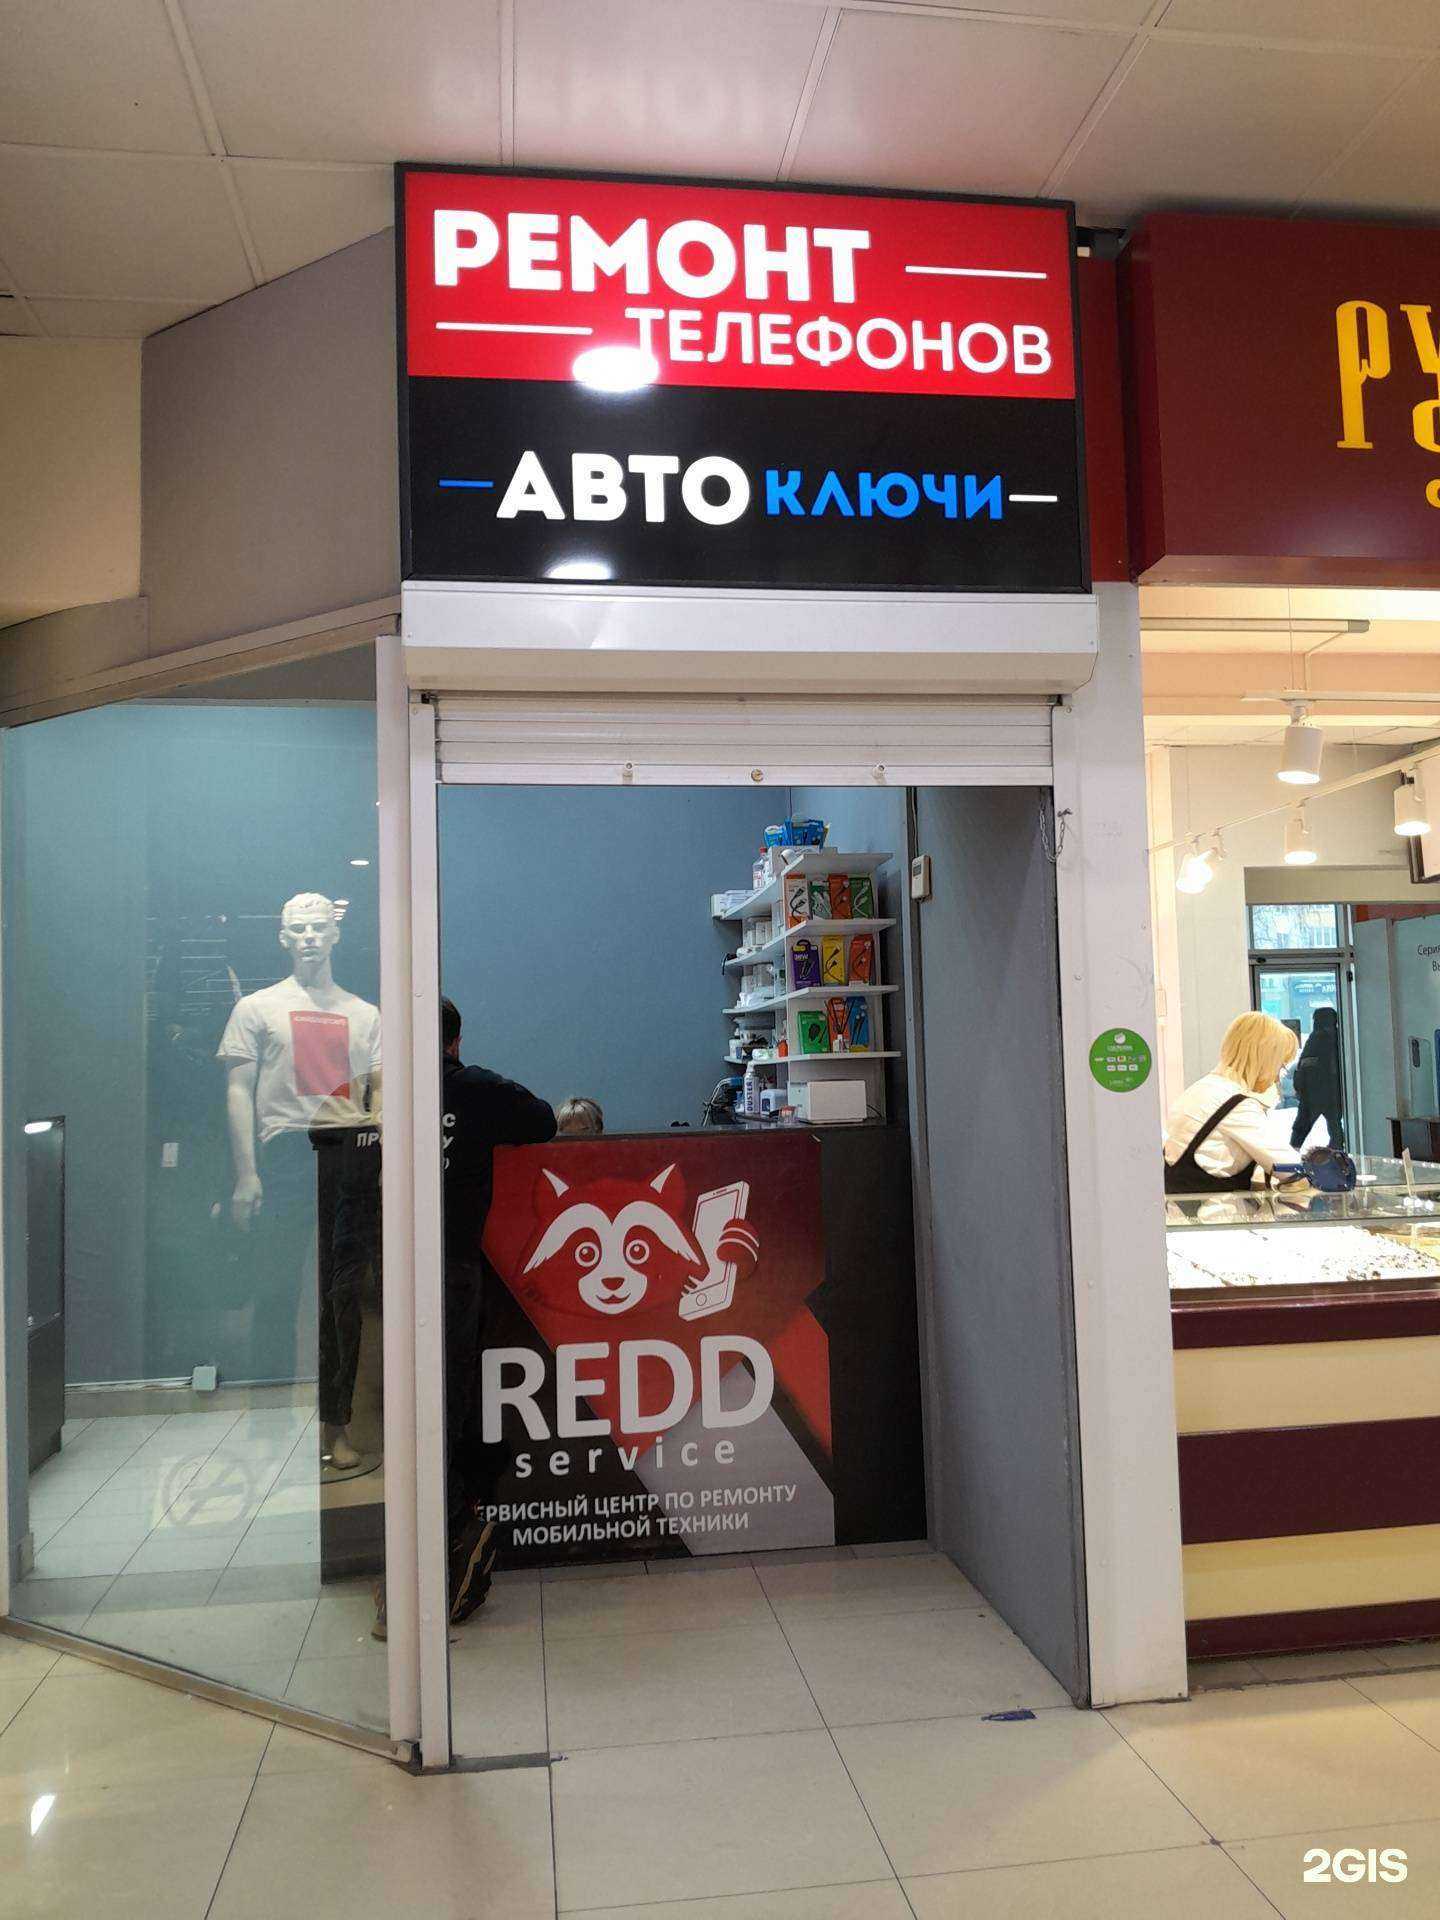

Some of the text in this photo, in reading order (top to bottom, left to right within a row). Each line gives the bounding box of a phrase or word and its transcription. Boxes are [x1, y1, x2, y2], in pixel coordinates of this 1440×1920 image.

[433, 209, 870, 304] РЕМОНТ
[625, 307, 1051, 376] ТЕЛЕФОНОВ
[496, 450, 1003, 526] АВТО КЛЮЧИ
[482, 1336, 774, 1443] REDD
[515, 1437, 735, 1478] service
[513, 1512, 750, 1546] МОБИЛЬНОЙ ТЕХНИКИ
[595, 1492, 660, 1518] ЦЕНТР
[665, 1491, 695, 1510] ПО
[700, 1485, 797, 1508] РЕМОНТУ
